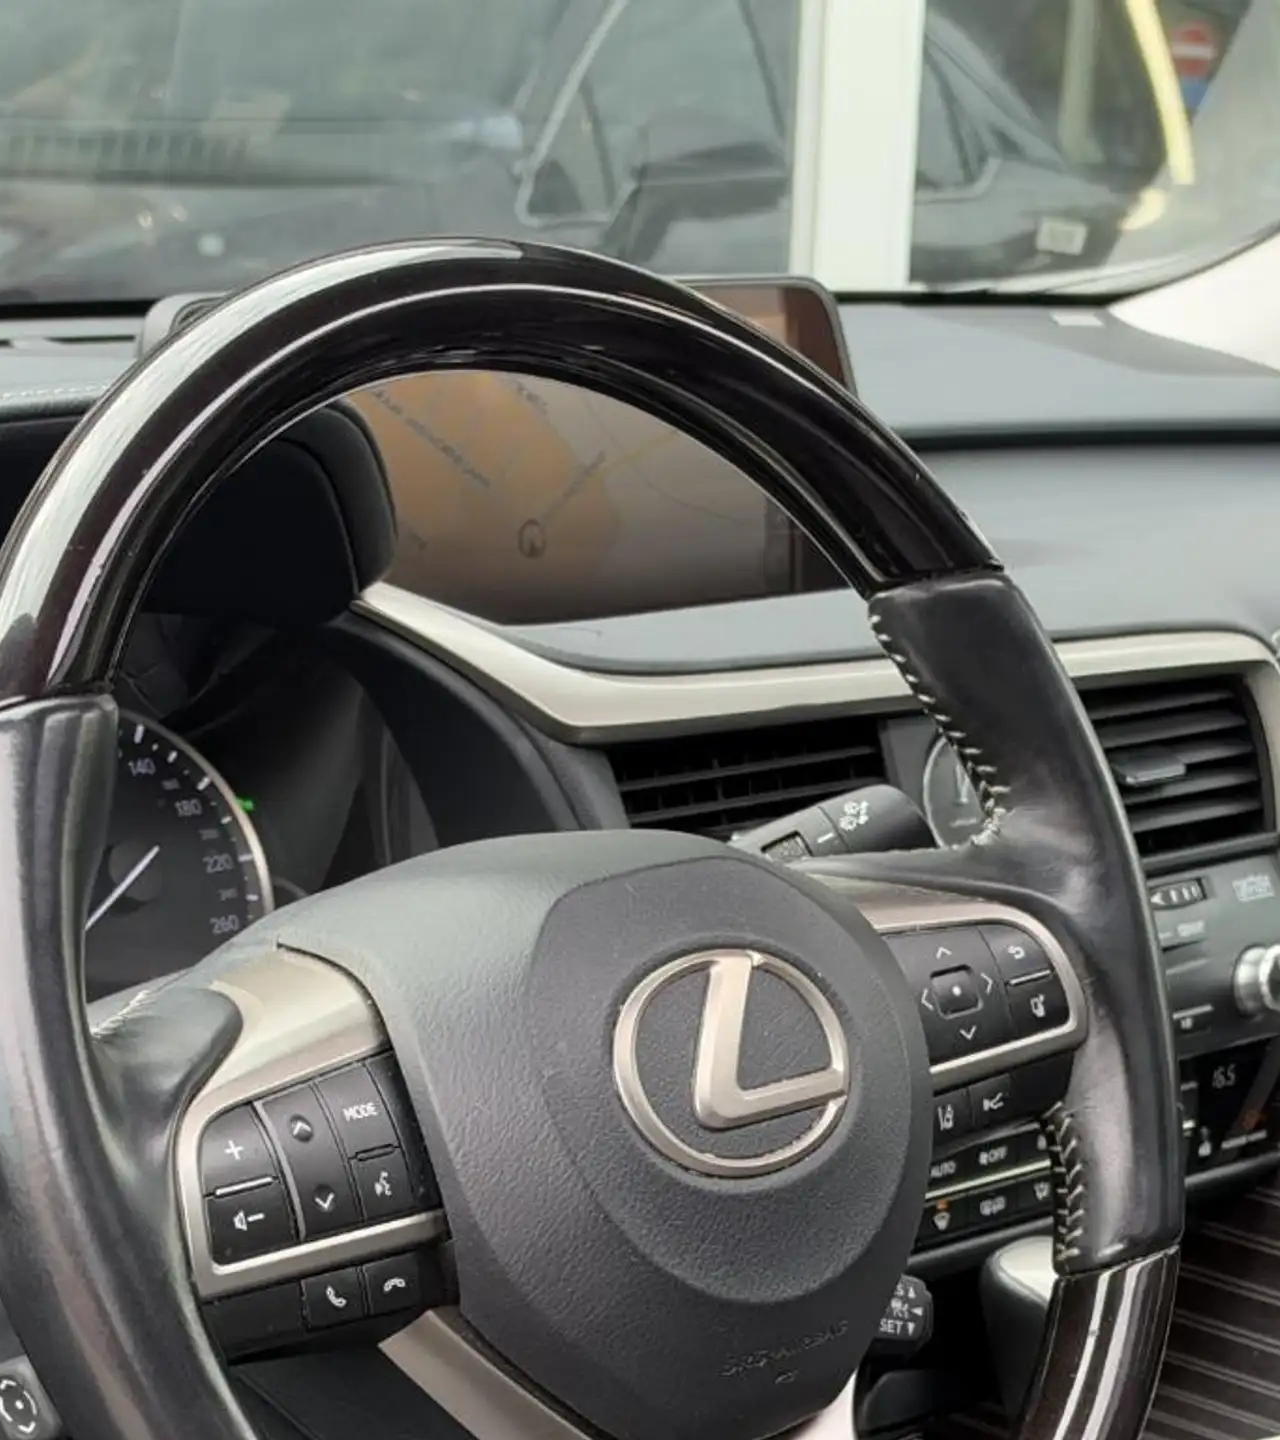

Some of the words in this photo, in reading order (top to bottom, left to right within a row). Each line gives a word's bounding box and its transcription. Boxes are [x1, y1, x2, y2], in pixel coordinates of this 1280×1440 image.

[203, 854, 234, 874] 220
[210, 914, 240, 934] 260
[343, 1101, 380, 1122] MODE
[880, 1317, 904, 1335] SET
